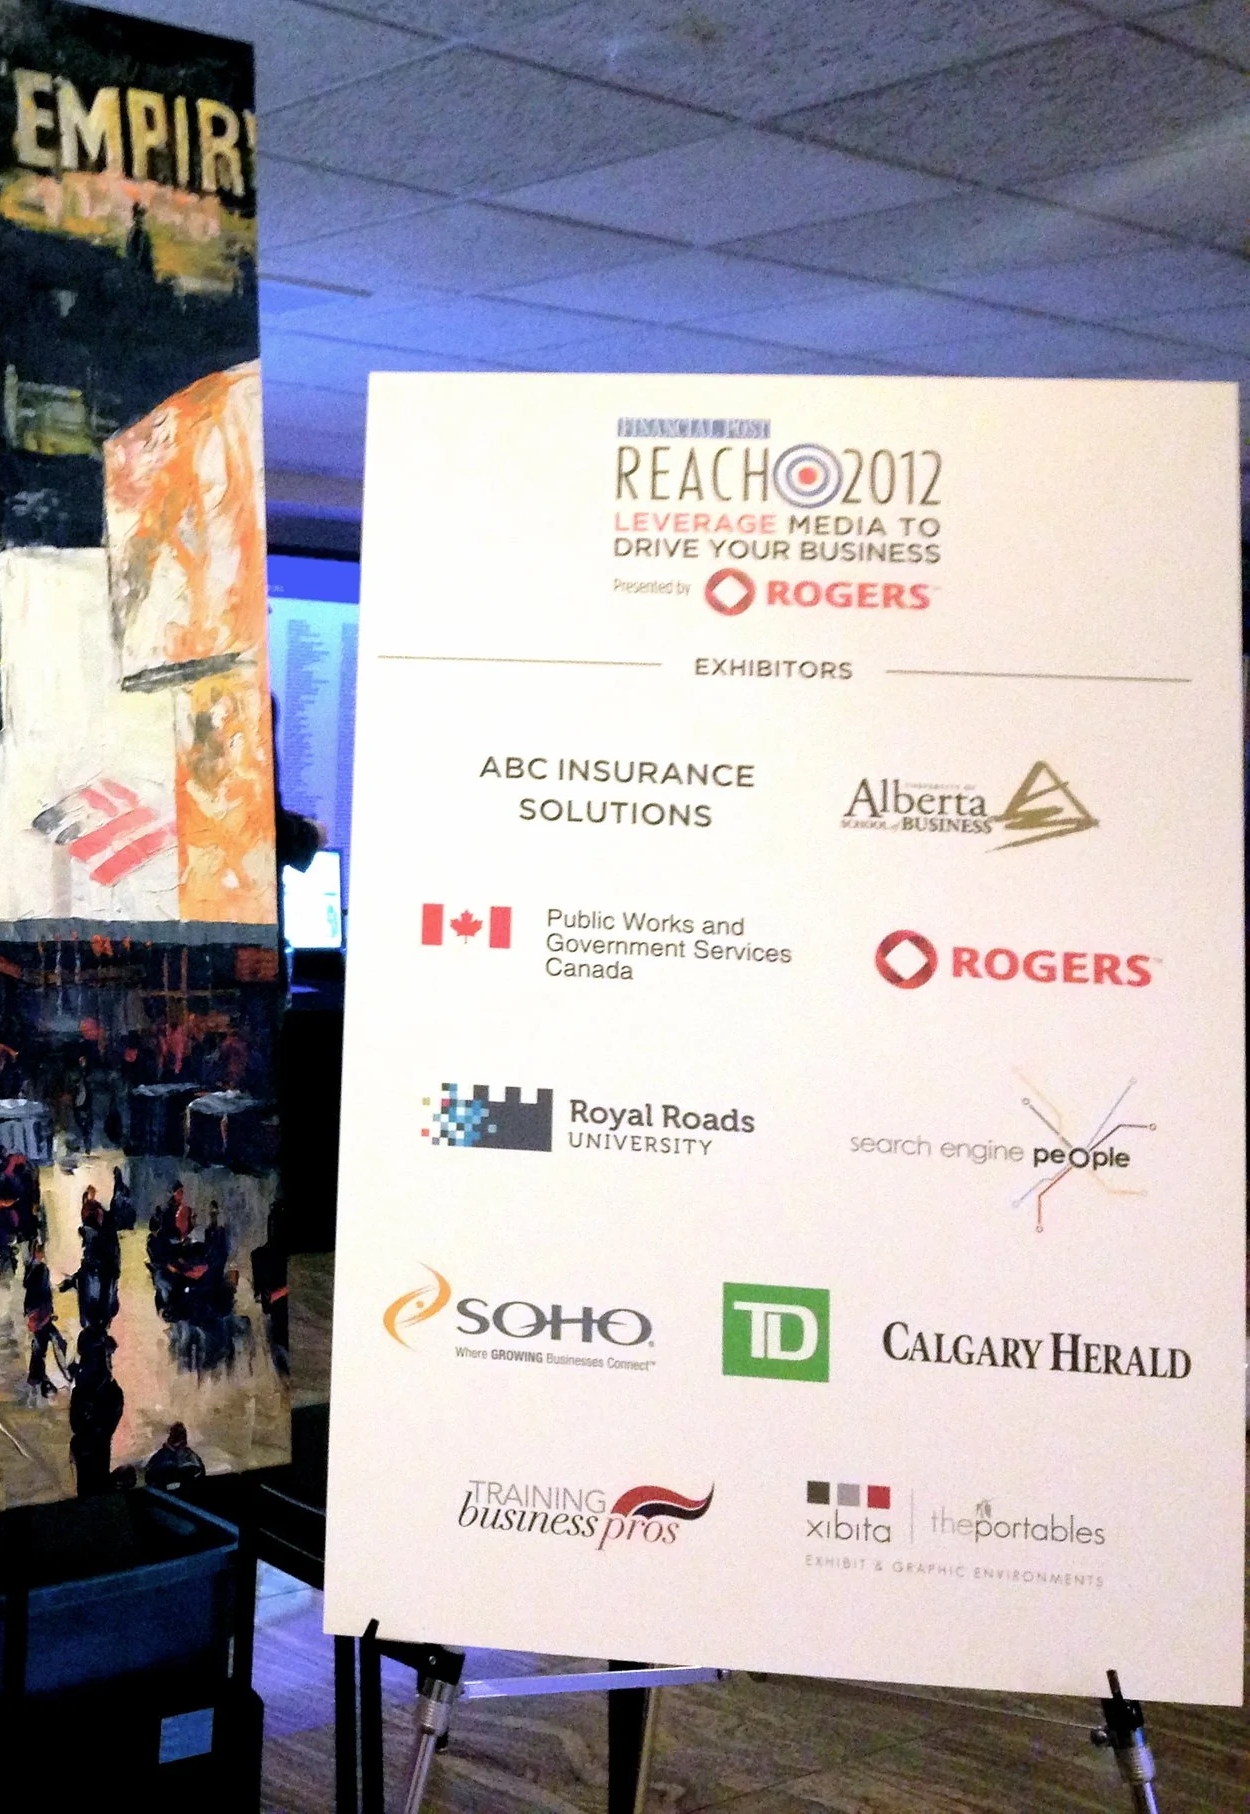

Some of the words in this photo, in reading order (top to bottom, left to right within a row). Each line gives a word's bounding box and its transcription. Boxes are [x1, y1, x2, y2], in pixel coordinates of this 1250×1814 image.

[14, 68, 257, 197] EMPIR
[616, 446, 769, 501] REACH
[841, 449, 942, 505] 2012
[614, 512, 777, 534] LEVERAGE
[789, 515, 887, 536] MEDIA
[898, 517, 941, 538] TO
[613, 537, 699, 558] DRIVE
[708, 539, 790, 560] YOUR
[800, 541, 942, 564] BUSINESS
[613, 578, 673, 595] Presented
[676, 579, 692, 597] by
[766, 580, 931, 610] ROGERS
[694, 657, 853, 680] EXHIBITORS
[479, 756, 548, 780] ABC
[558, 758, 755, 788] INSURANCE
[519, 798, 712, 828] SOLUTIONS
[843, 778, 988, 818] Alberta
[901, 816, 993, 834] BUSINESS
[547, 908, 615, 930] Public
[623, 911, 694, 934] Works
[701, 917, 745, 937] and
[546, 932, 686, 958] Government
[693, 939, 792, 964] Services
[545, 957, 634, 980] Canada
[952, 946, 1152, 987] ROGERS
[569, 1098, 654, 1132] Royal
[661, 1104, 756, 1134] Roads
[568, 1131, 712, 1156] UNIVERSITY
[850, 1134, 931, 1157] search
[940, 1140, 1024, 1165] engine
[456, 1298, 653, 1346] SOHO
[733, 1301, 819, 1362] TD
[455, 1345, 488, 1360] Where
[491, 1348, 543, 1364] GROWING
[546, 1353, 604, 1369] Businesses
[882, 1321, 1044, 1370] CALGARY
[1049, 1332, 1192, 1380] HERALD
[468, 1480, 607, 1514] TRAINING
[457, 1490, 599, 1538] business
[594, 1512, 680, 1551] pros
[806, 1508, 891, 1543] xibita
[805, 1554, 867, 1570] EXHIBIT
[874, 1562, 883, 1572] &
[892, 1561, 967, 1579] GRAPHIC
[973, 1568, 1104, 1588] ENVIRONMENTS
